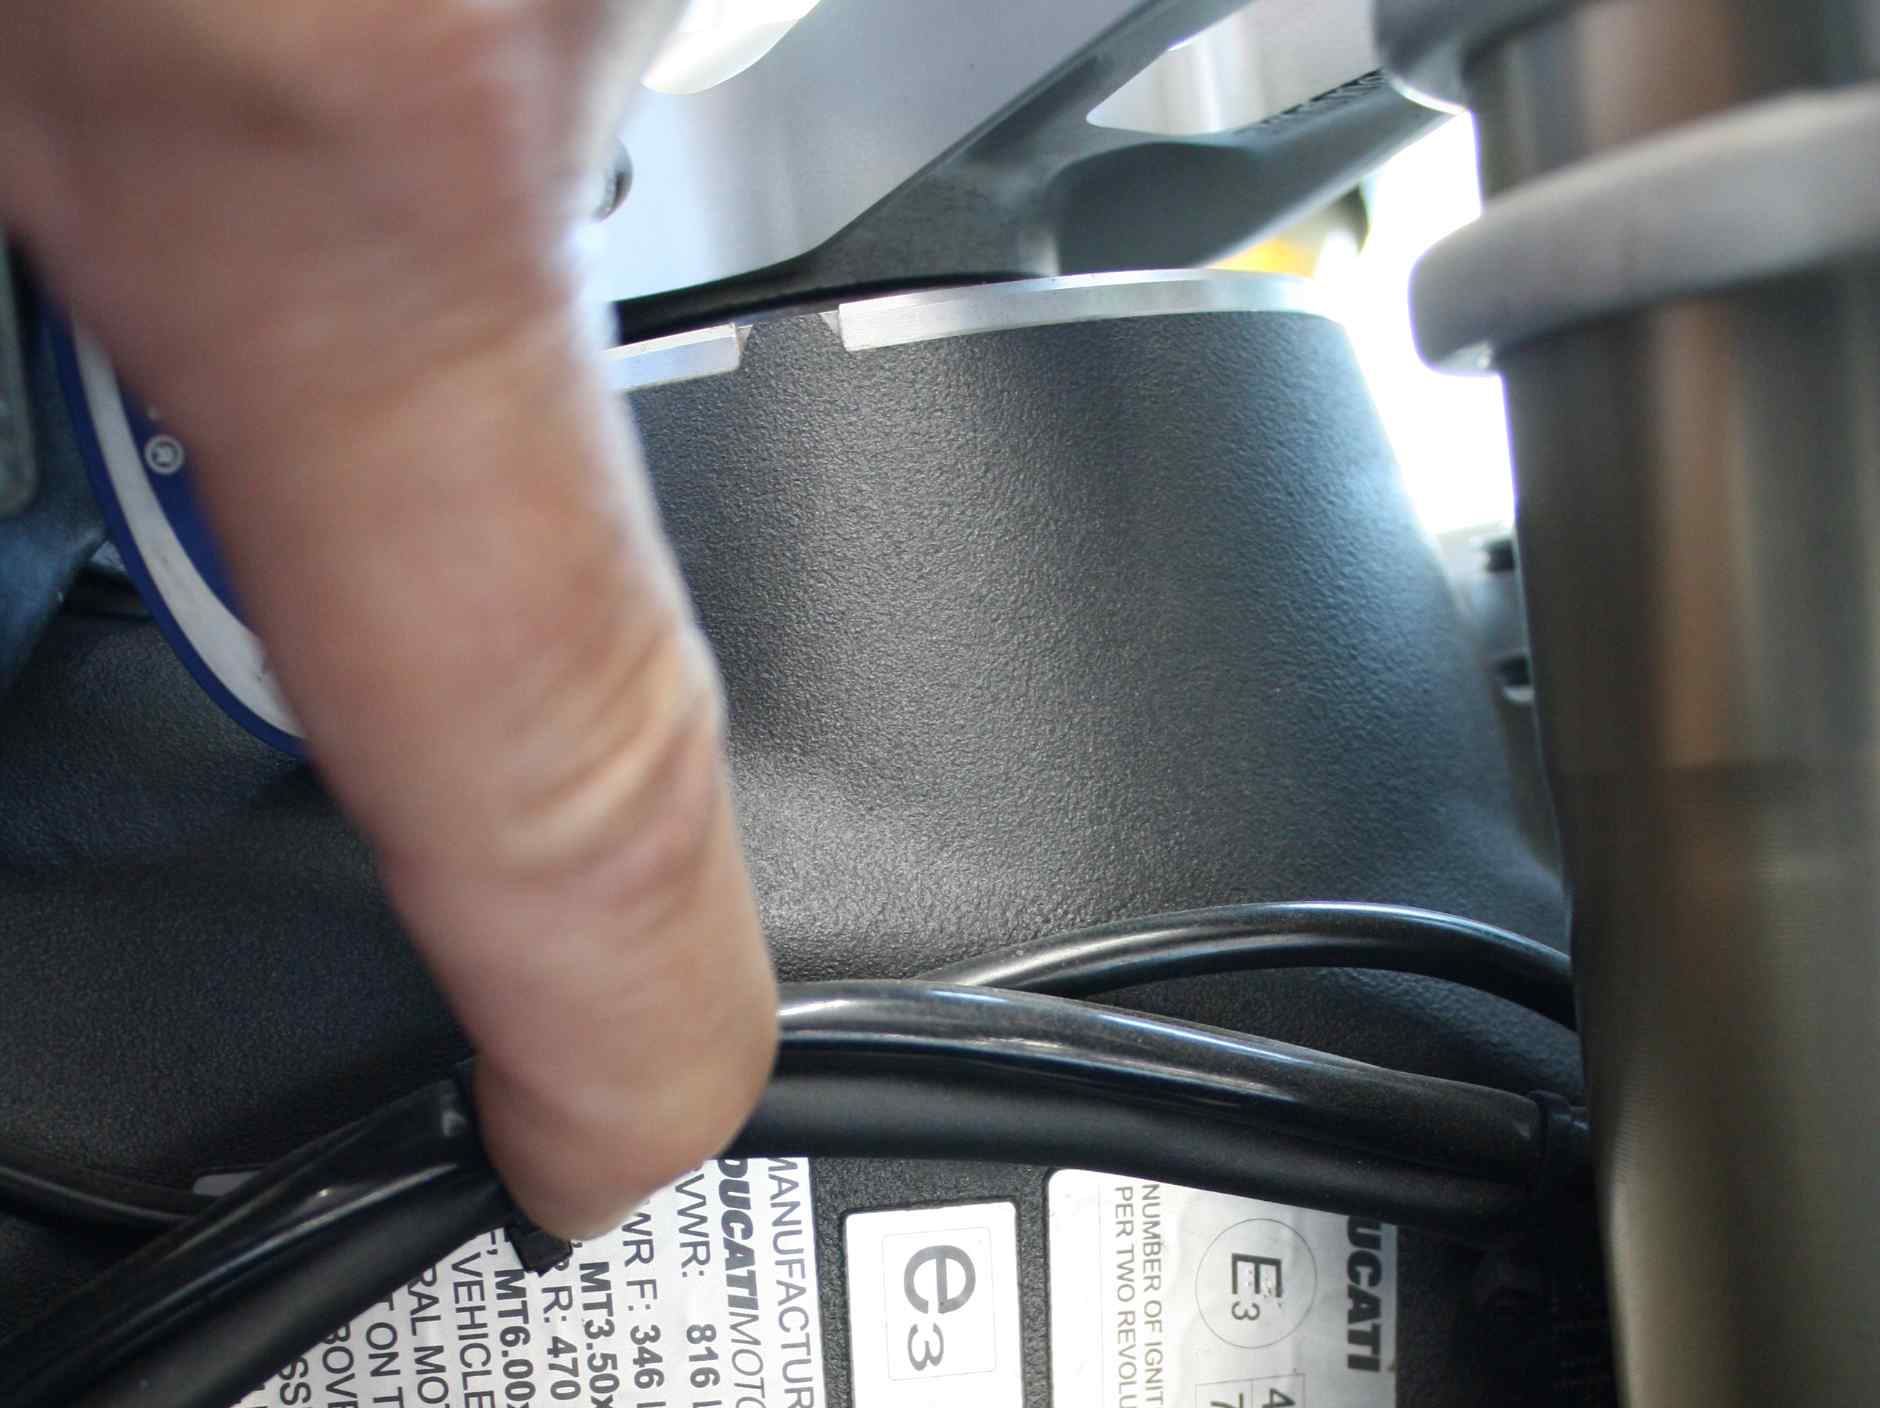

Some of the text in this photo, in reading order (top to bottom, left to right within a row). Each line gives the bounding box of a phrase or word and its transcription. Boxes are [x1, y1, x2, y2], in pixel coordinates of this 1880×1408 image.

[675, 1171, 710, 1277] VWR:
[1115, 1187, 1135, 1238] PER
[1141, 1184, 1162, 1292] NUMBER
[627, 1279, 657, 1311] F:
[1116, 1244, 1136, 1302] TWO
[1347, 1217, 1381, 1372] UCATI
[542, 1286, 573, 1322] R:
[1143, 1301, 1163, 1333] OF
[366, 1323, 399, 1377] ON
[548, 1336, 580, 1400] 470
[630, 1325, 664, 1389] 346
[687, 1324, 719, 1388] 816
